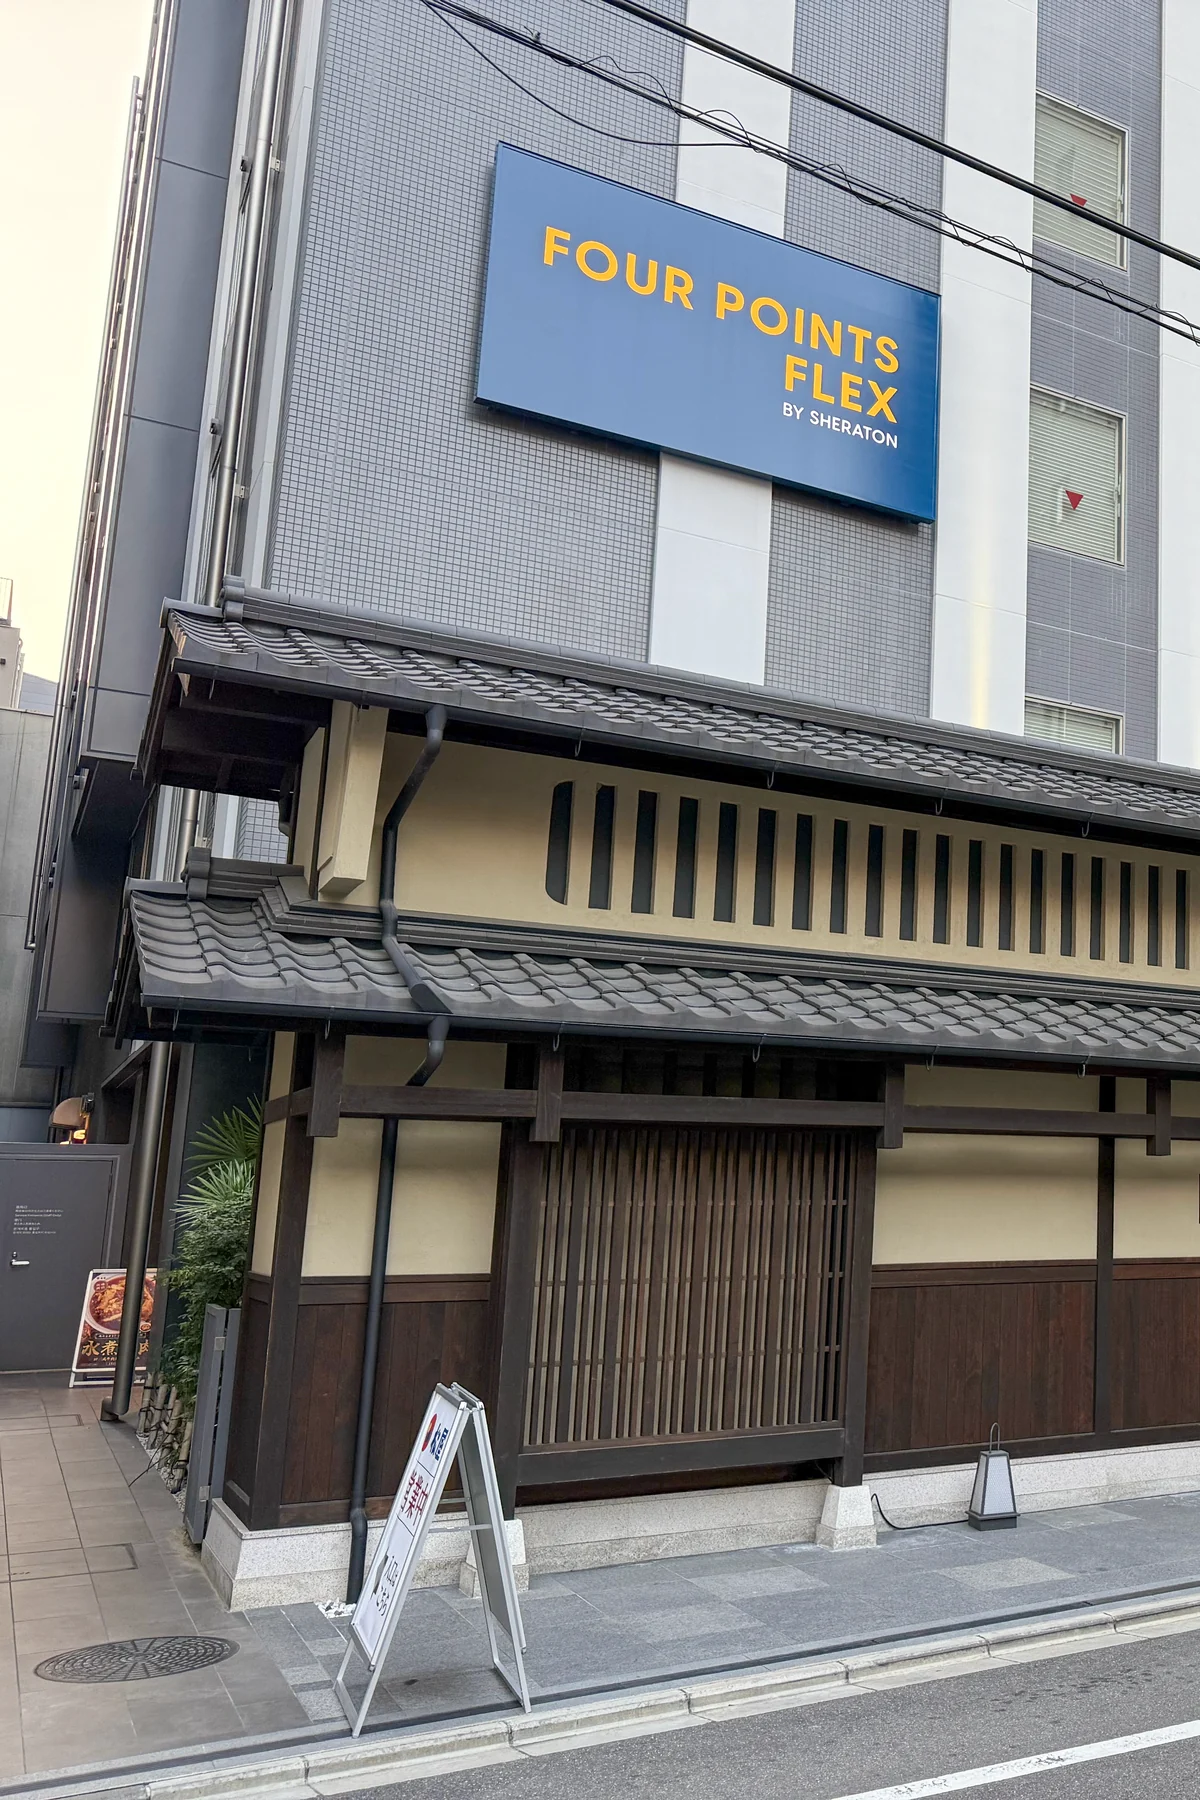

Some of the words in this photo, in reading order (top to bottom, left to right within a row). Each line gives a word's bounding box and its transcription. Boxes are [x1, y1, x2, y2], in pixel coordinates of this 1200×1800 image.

[543, 225, 694, 310] FOUR
[715, 282, 900, 374] POINTS
[785, 354, 898, 424] FLEX
[782, 402, 804, 420] BY
[809, 410, 898, 449] SHERATON
